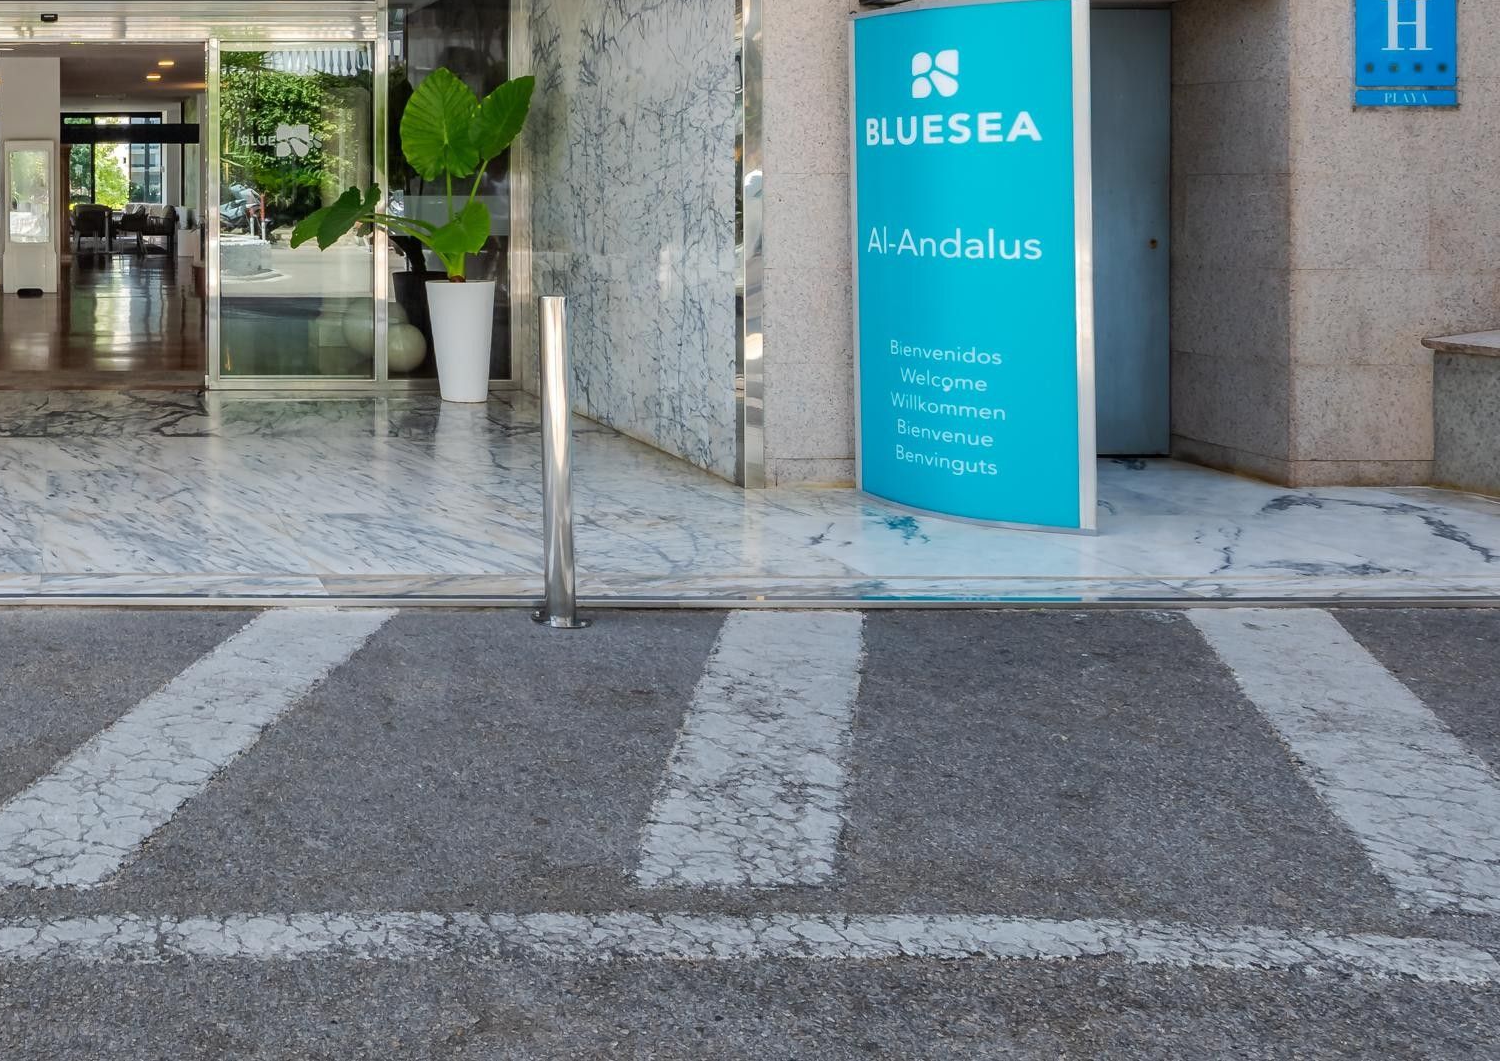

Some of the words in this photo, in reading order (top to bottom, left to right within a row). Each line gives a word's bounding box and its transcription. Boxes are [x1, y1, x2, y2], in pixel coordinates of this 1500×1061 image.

[1384, 92, 1428, 104] PLAYA
[866, 111, 1043, 146] BLUESEA
[867, 226, 1043, 260] Al-Andalus
[890, 340, 1003, 365] Bienvenidos
[901, 367, 988, 391] Welcome
[891, 391, 1006, 421] Willkommen
[897, 419, 994, 447] Bienvenue
[896, 444, 998, 476] Benvinguts
